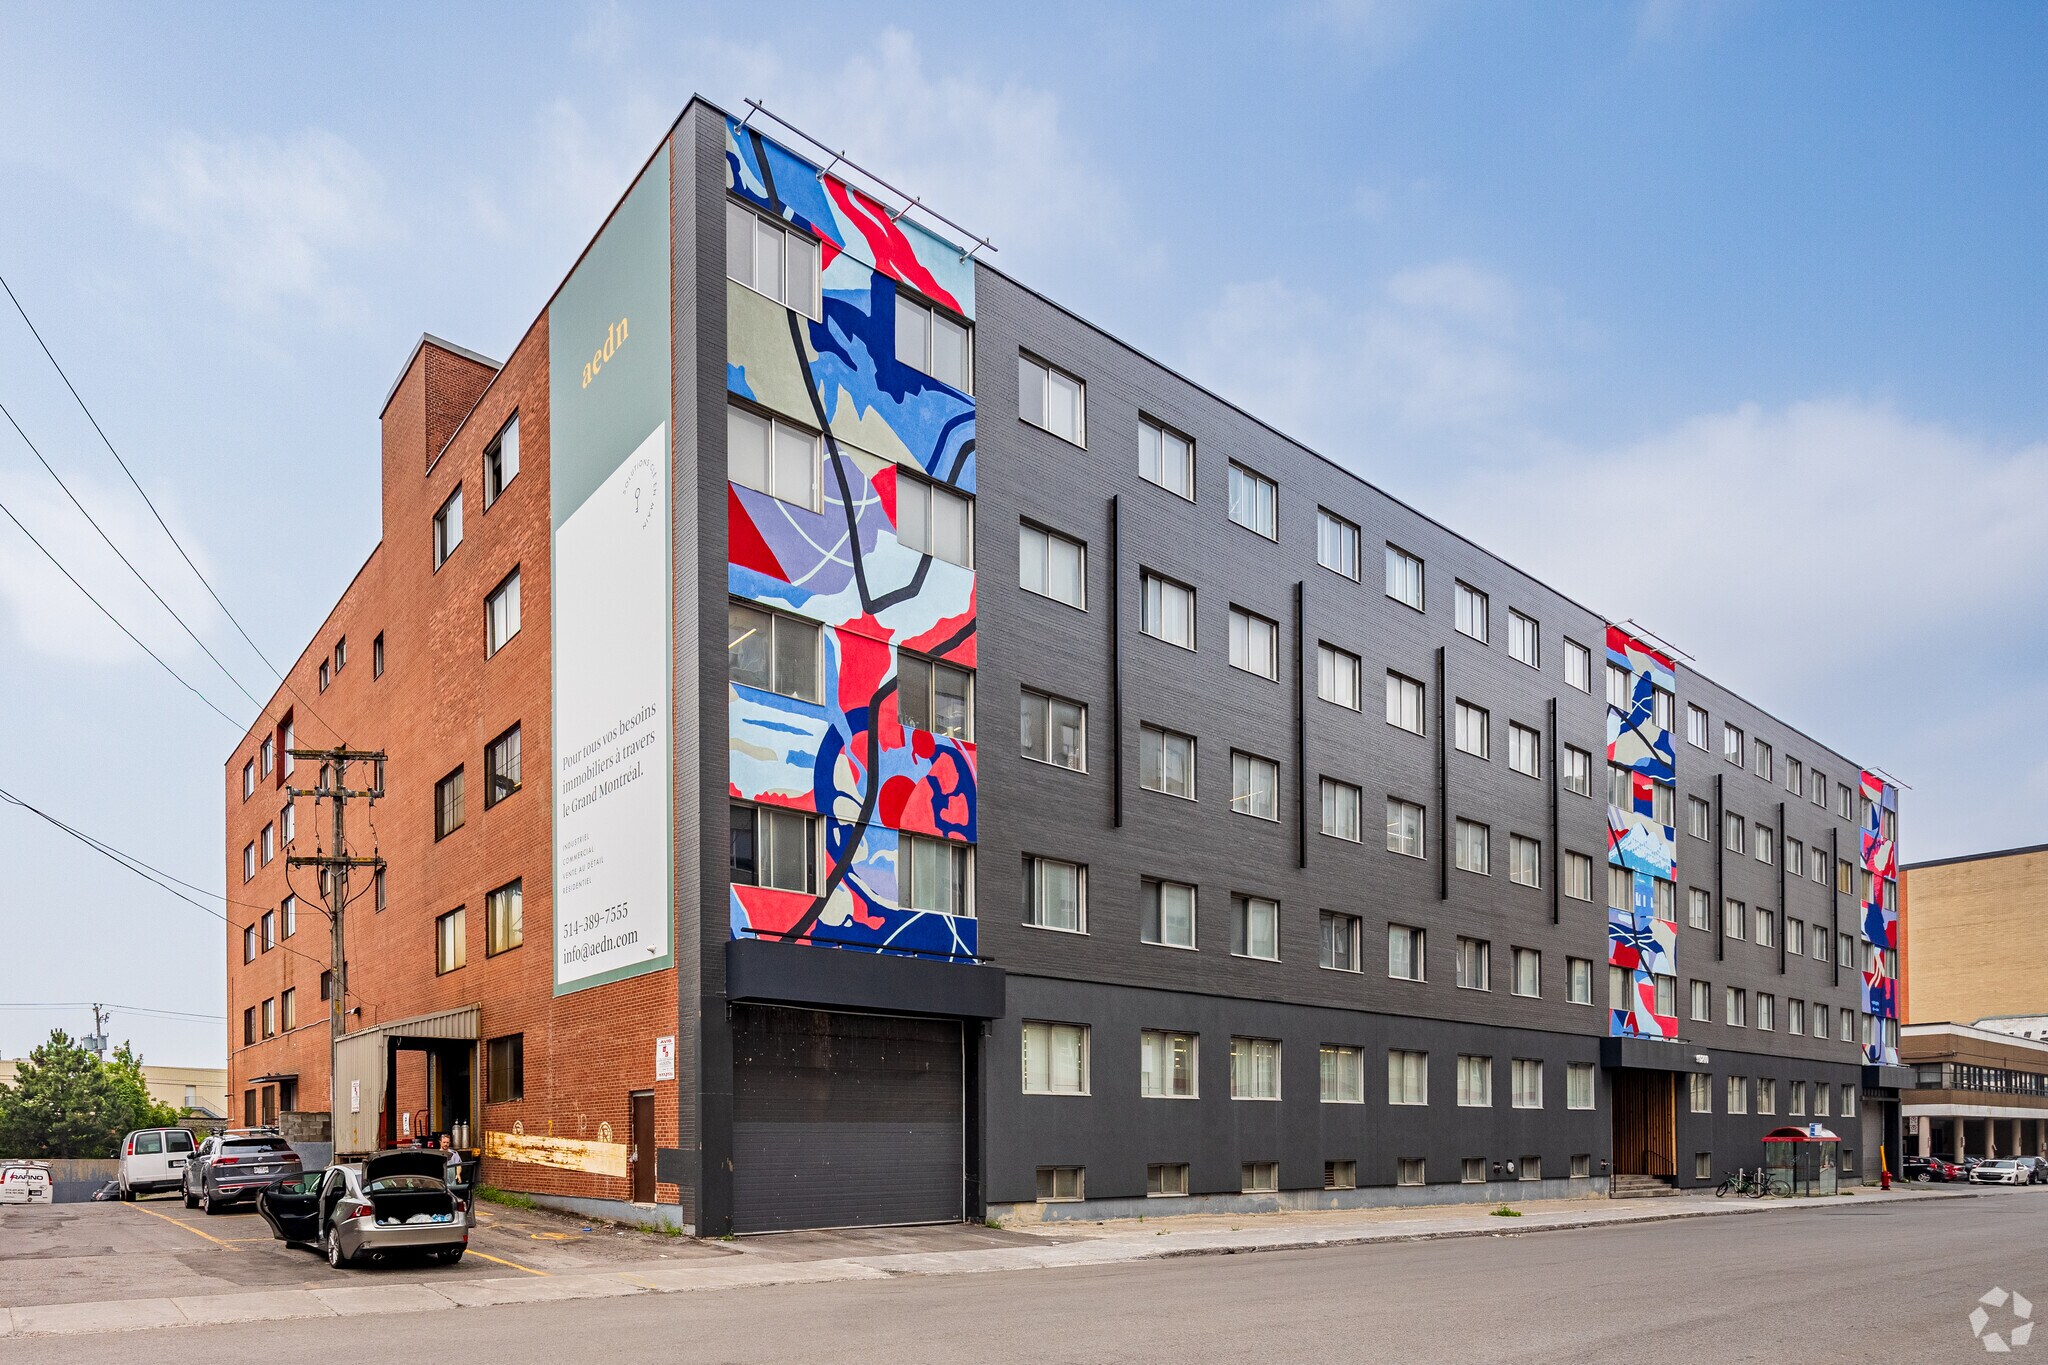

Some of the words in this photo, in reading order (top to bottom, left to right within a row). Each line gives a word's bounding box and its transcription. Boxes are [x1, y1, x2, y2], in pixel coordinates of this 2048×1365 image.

[581, 317, 629, 389] aedn
[562, 750, 582, 771] Pour
[583, 737, 602, 759] tous
[602, 727, 618, 745] vos
[619, 702, 657, 736] besoins
[562, 755, 614, 795] immobiliers
[615, 747, 621, 764] à
[622, 730, 656, 760] travers
[562, 803, 570, 819] le
[571, 785, 597, 813] Grand
[599, 761, 644, 799] Montréal.
[562, 833, 590, 852] INDUSTRIEL
[562, 845, 595, 866] COMMERCIAL
[562, 867, 577, 880] VENTE
[578, 864, 586, 873] AU
[587, 856, 604, 870] DÉTAIL
[562, 876, 592, 895] RÉSIDENTIEL
[563, 902, 629, 939] 514-389-7555
[563, 930, 639, 965] info@aedn.com
